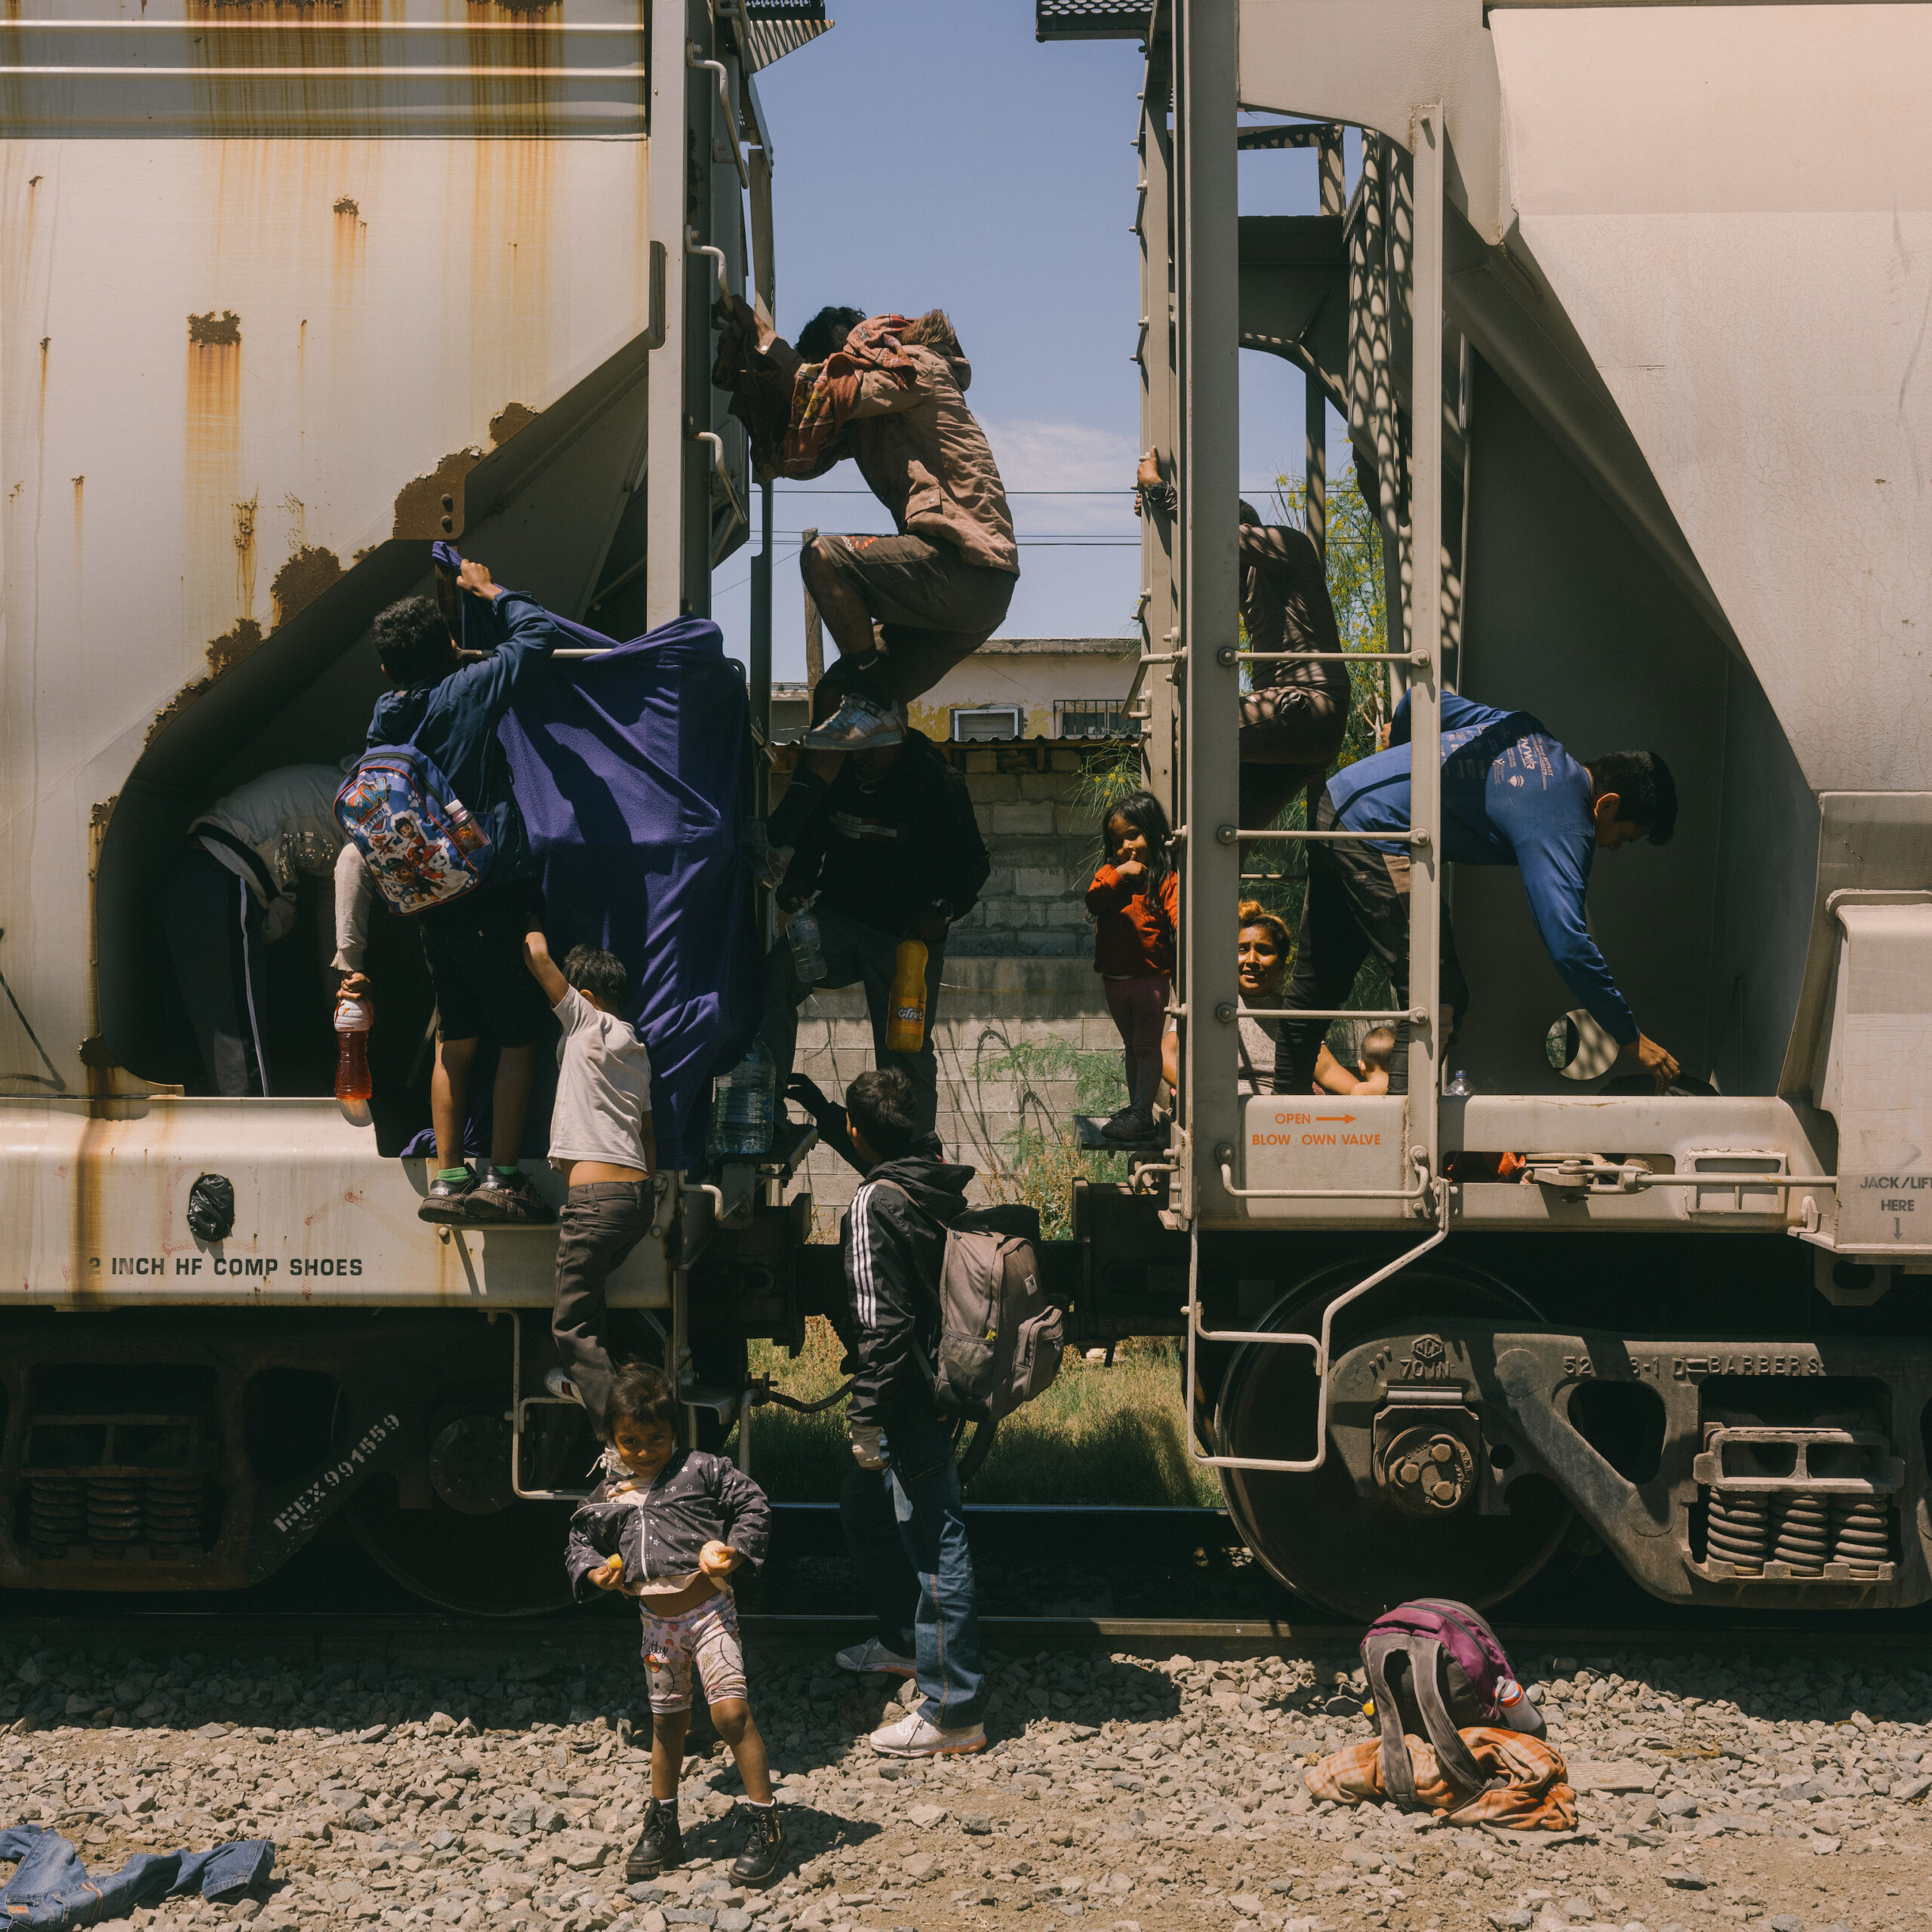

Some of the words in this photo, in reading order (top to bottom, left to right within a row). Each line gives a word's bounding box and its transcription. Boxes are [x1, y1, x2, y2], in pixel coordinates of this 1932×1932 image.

[343, 777, 387, 827] PAW
[364, 807, 389, 832] PATROL
[1275, 1113, 1311, 1124] OPEN
[1252, 1134, 1291, 1146] BLOW
[1342, 1134, 1381, 1146] VALVE
[1881, 1199, 1915, 1211] HERE
[88, 1257, 100, 1275] 2
[112, 1258, 165, 1275] INCH
[176, 1258, 202, 1275] HF
[214, 1258, 278, 1275] COMP
[290, 1258, 363, 1276] SHOES
[1400, 1359, 1425, 1377] 70
[642, 1636, 669, 1658] Kitty
